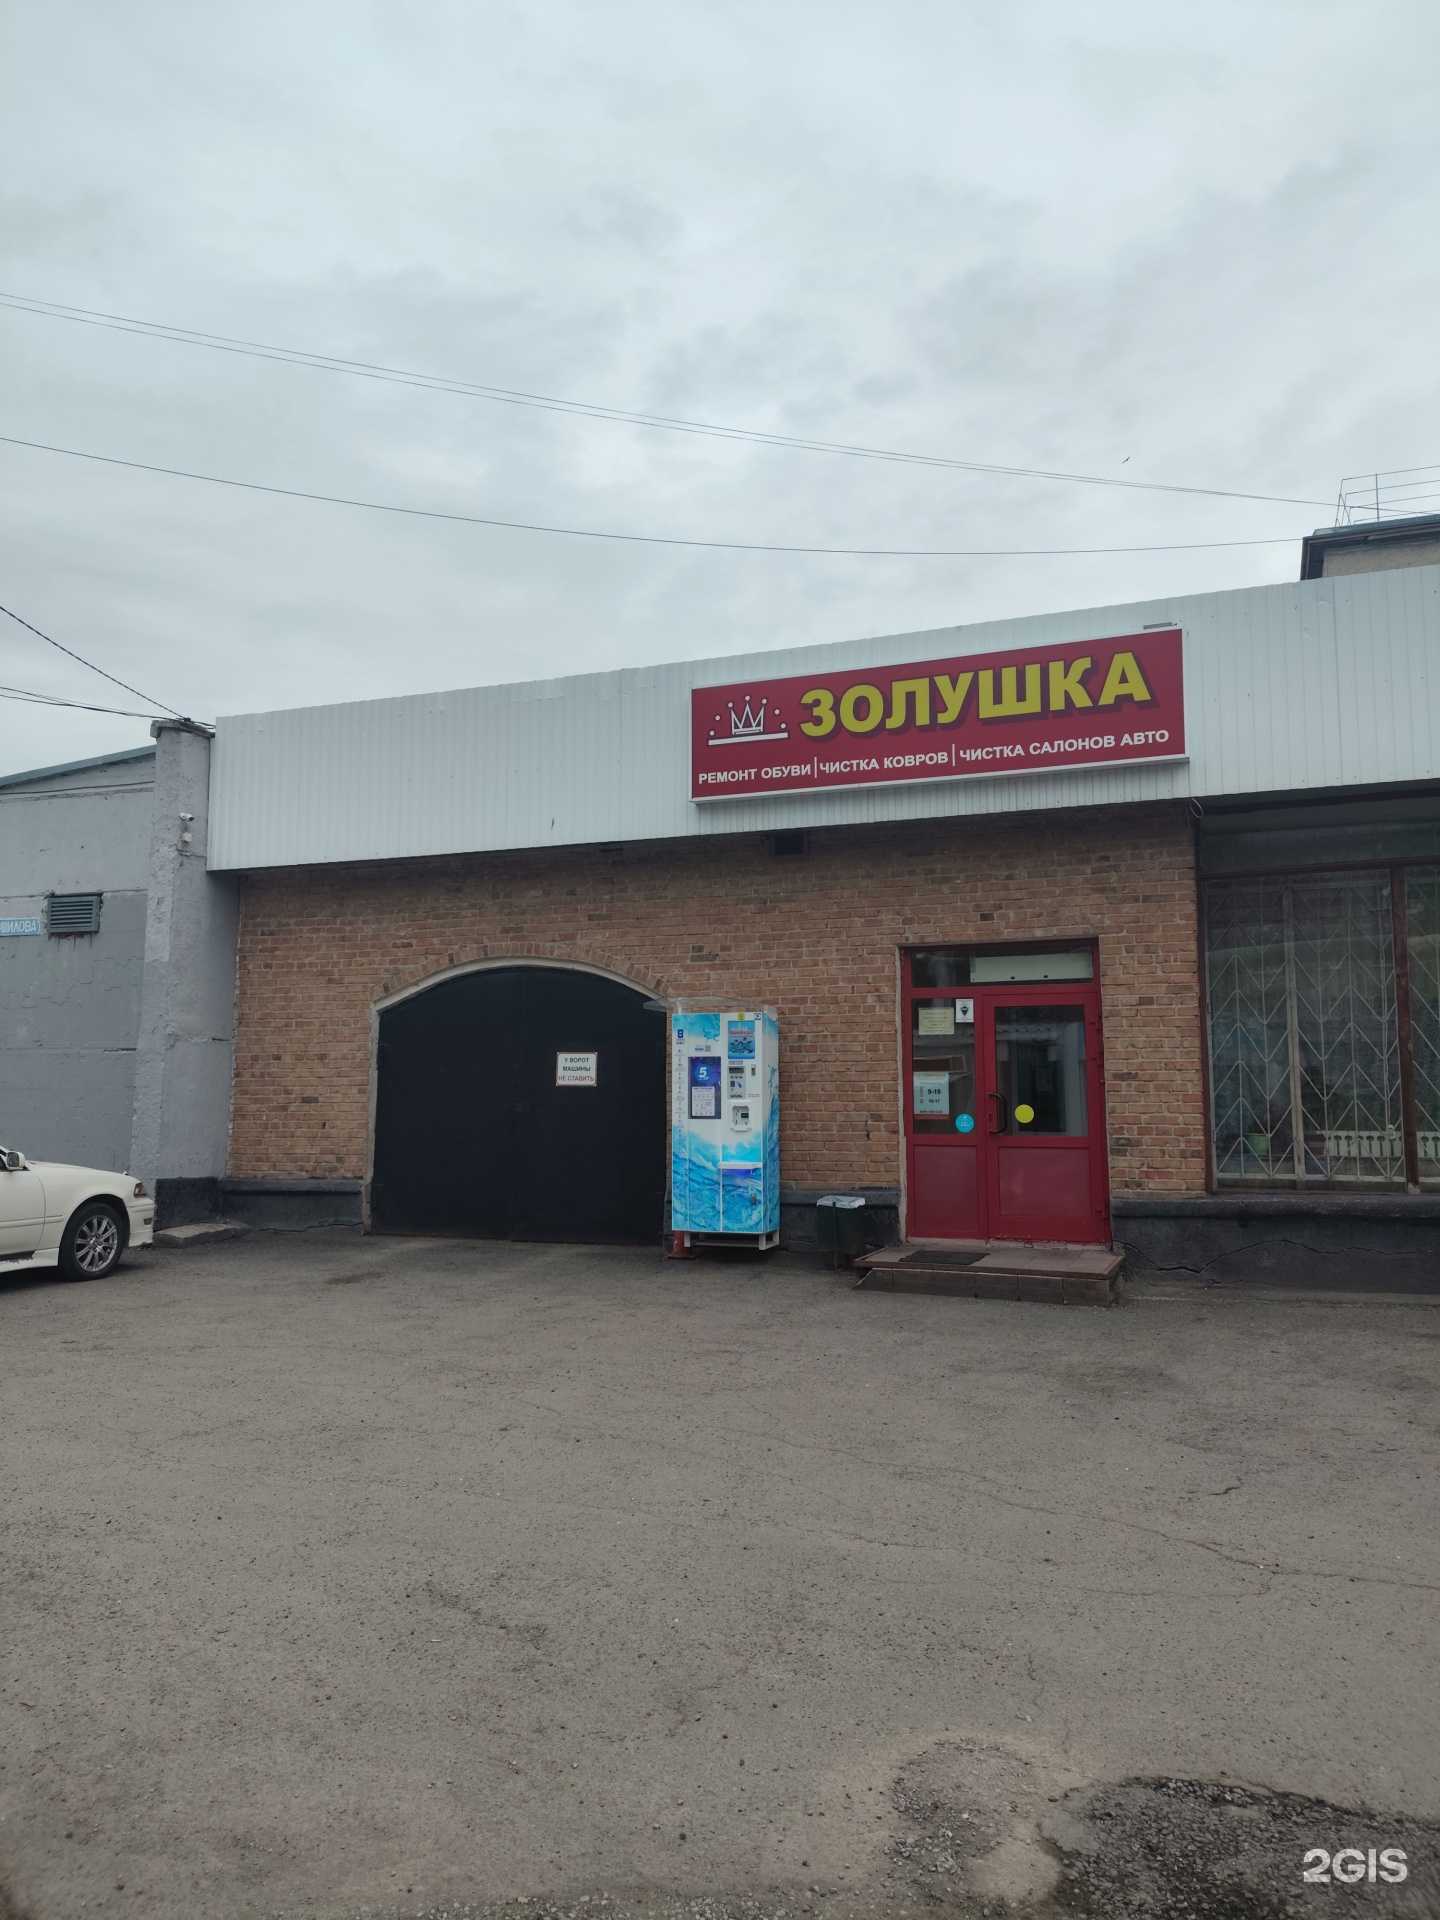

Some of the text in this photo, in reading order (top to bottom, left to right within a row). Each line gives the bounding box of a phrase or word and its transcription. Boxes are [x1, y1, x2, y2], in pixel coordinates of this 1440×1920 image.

[799, 651, 1152, 737] ЗОЛУШКА
[698, 729, 1170, 784] РЕМОНТ ОБУВИ ЧИСТКА КОВРОВ ЧИСТКА САЛОНОВ АВТО
